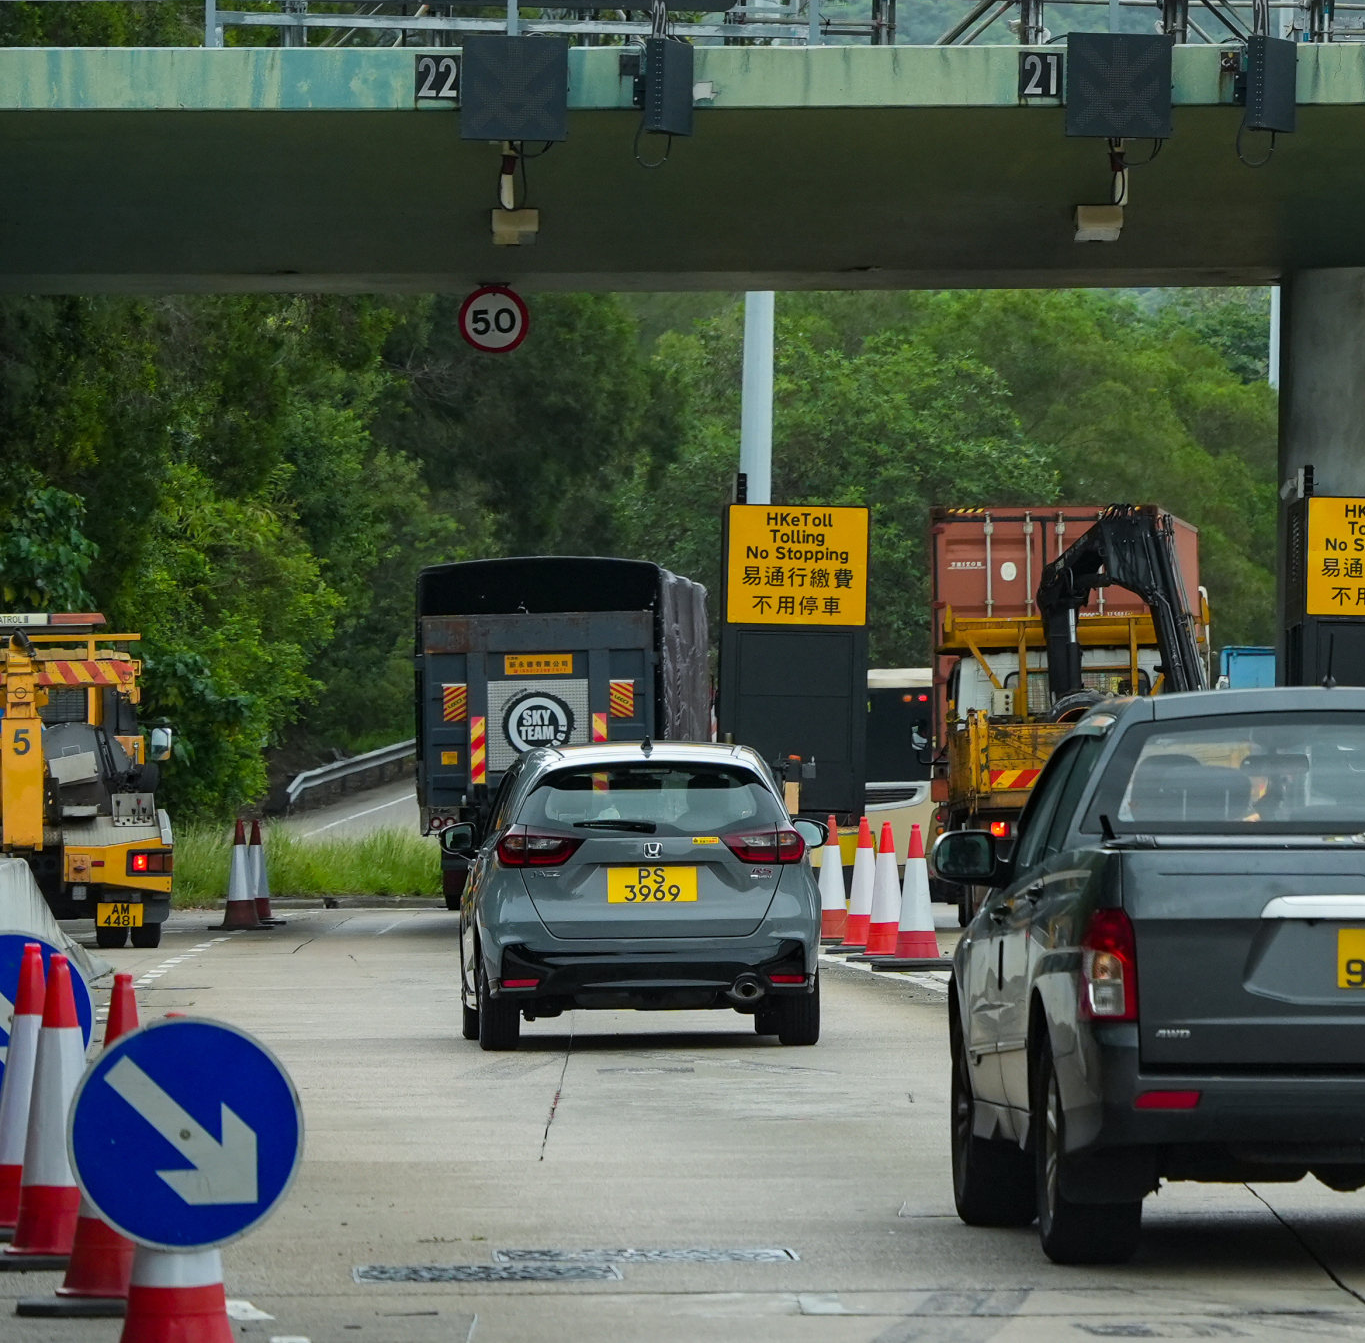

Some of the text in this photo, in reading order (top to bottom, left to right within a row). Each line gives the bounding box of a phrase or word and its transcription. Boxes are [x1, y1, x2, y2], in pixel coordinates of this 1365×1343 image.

[418, 57, 458, 97] 22
[1024, 54, 1058, 95] 21
[471, 307, 517, 336] 50
[766, 512, 834, 527] HKeToll
[769, 529, 825, 547] Tolling
[1325, 537, 1348, 551] No
[746, 545, 849, 564] No Stopping
[742, 565, 854, 589] 易通行繳費
[751, 595, 842, 616] 不用停車
[522, 709, 551, 726] SKY
[13, 728, 31, 756] 5
[519, 725, 555, 741] TEAM
[638, 868, 666, 885] PS
[624, 884, 681, 902] 3969
[111, 903, 130, 915] AM
[103, 915, 136, 926] 4481
